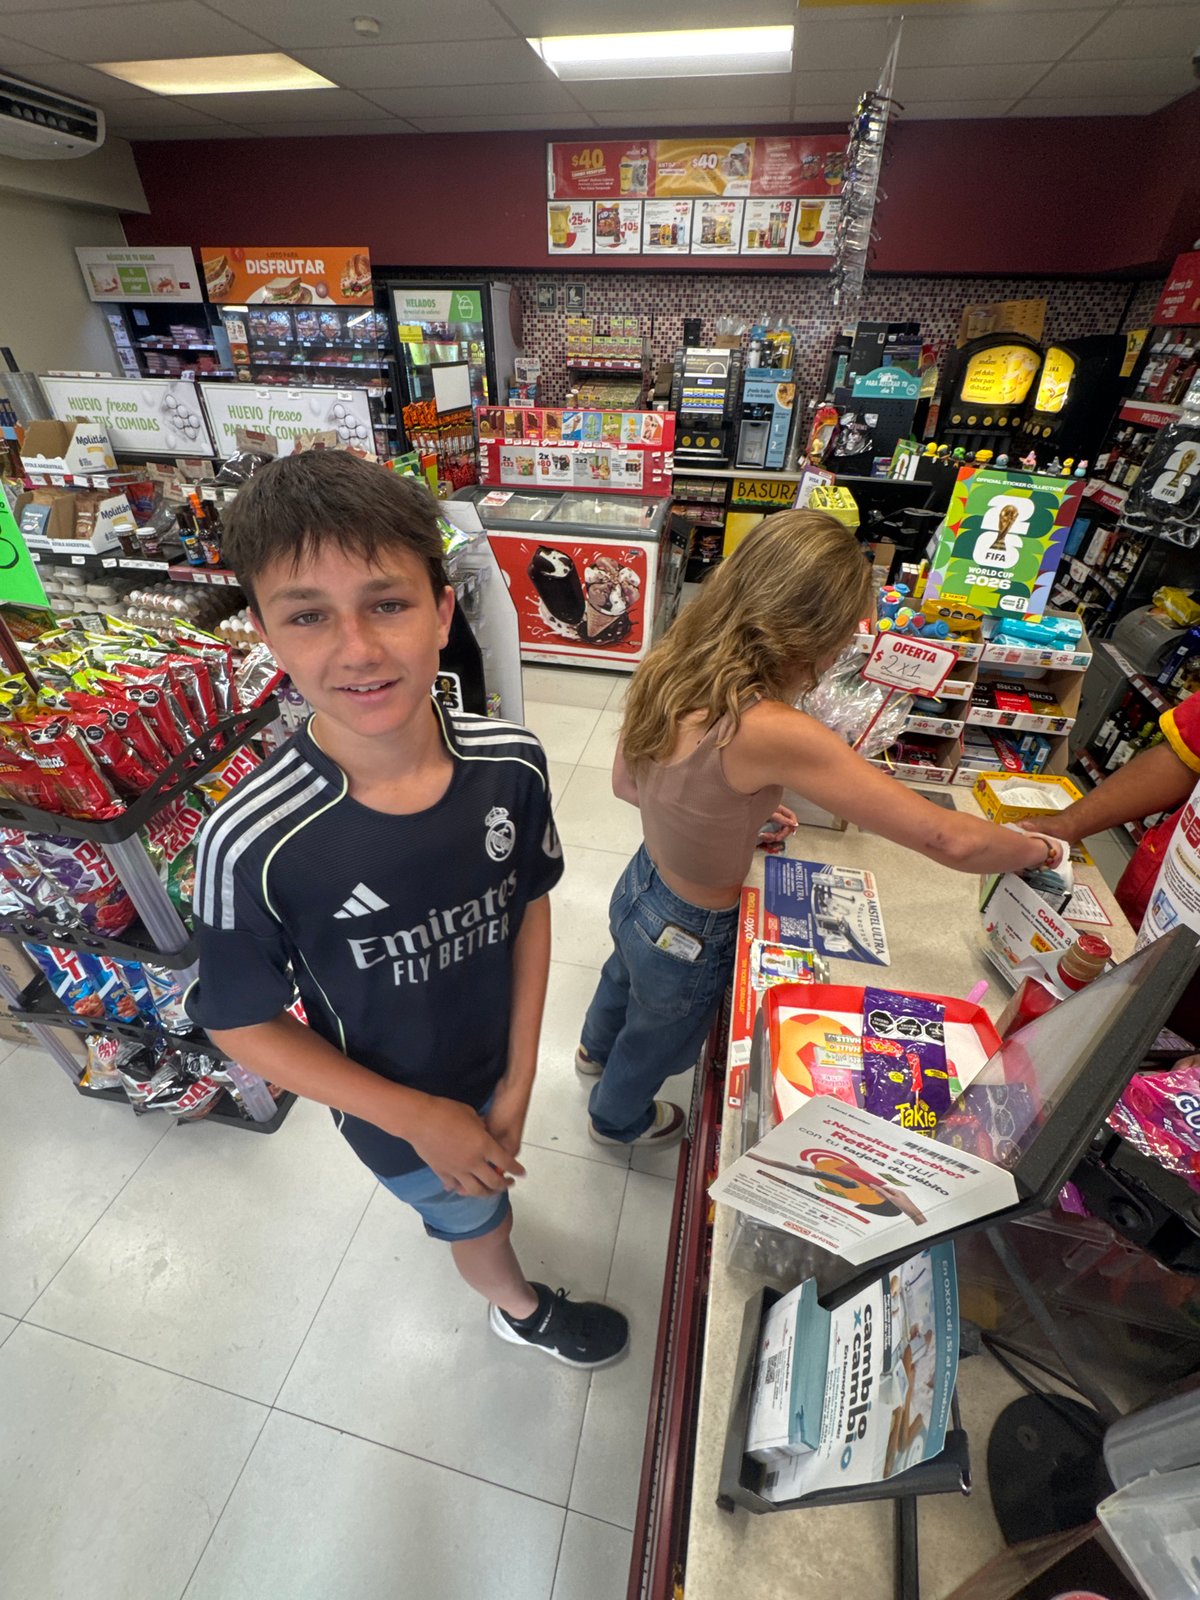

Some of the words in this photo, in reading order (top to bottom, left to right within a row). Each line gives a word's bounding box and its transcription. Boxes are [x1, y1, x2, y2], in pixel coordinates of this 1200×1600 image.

[571, 148, 605, 169] $40
[692, 153, 718, 170] $40
[245, 259, 325, 275] DISFRUTAR
[405, 298, 437, 308] HELADOS
[67, 397, 102, 412] HUEVO
[106, 397, 139, 414] fresco
[227, 405, 264, 421] HUEVO
[268, 406, 303, 423] fresco
[115, 416, 161, 433] COMIDAS
[538, 452, 550, 460] 2x
[737, 482, 799, 500] BASURA
[976, 477, 1001, 485] OFFICIAL
[1002, 480, 1027, 488] STICKER
[1027, 482, 1064, 493] COLLECTION
[1161, 487, 1177, 498] FIFA
[985, 552, 1006, 562] FIFA
[968, 566, 997, 577] WORLD
[997, 570, 1014, 579] CUP
[964, 574, 1011, 590] 2026
[873, 649, 884, 664] $
[892, 640, 938, 664] OFERTA
[996, 683, 1022, 692] SICO
[1027, 692, 1054, 701] SICO
[795, 861, 804, 881] AMSTEL
[795, 881, 805, 901] ULTRA
[346, 869, 518, 970] Emirates
[867, 899, 880, 928] AMSTEL
[857, 903, 872, 948] COLLECTION
[1037, 908, 1065, 939] Cobra
[393, 953, 431, 986] FLY
[439, 911, 510, 971] BETTER
[872, 927, 885, 956] ULTRA
[836, 1044, 861, 1053] HALLS
[895, 1102, 937, 1128] Takis
[822, 1118, 898, 1153] ¿Necesitas
[898, 1149, 967, 1181] efectivo?
[830, 1130, 889, 1161] Retira
[892, 1156, 938, 1180] aquí
[798, 1126, 822, 1139] con
[825, 1137, 840, 1148] tu
[842, 1144, 886, 1170] tarjeta
[886, 1163, 903, 1175] de
[905, 1170, 950, 1197] débito
[941, 1259, 949, 1277] En
[943, 1278, 953, 1316] OXXO
[853, 1308, 862, 1330] x
[945, 1318, 953, 1332] di
[844, 1344, 850, 1359] En
[945, 1355, 953, 1368] al
[857, 1303, 873, 1440] cambio
[838, 1362, 849, 1419] beneficio
